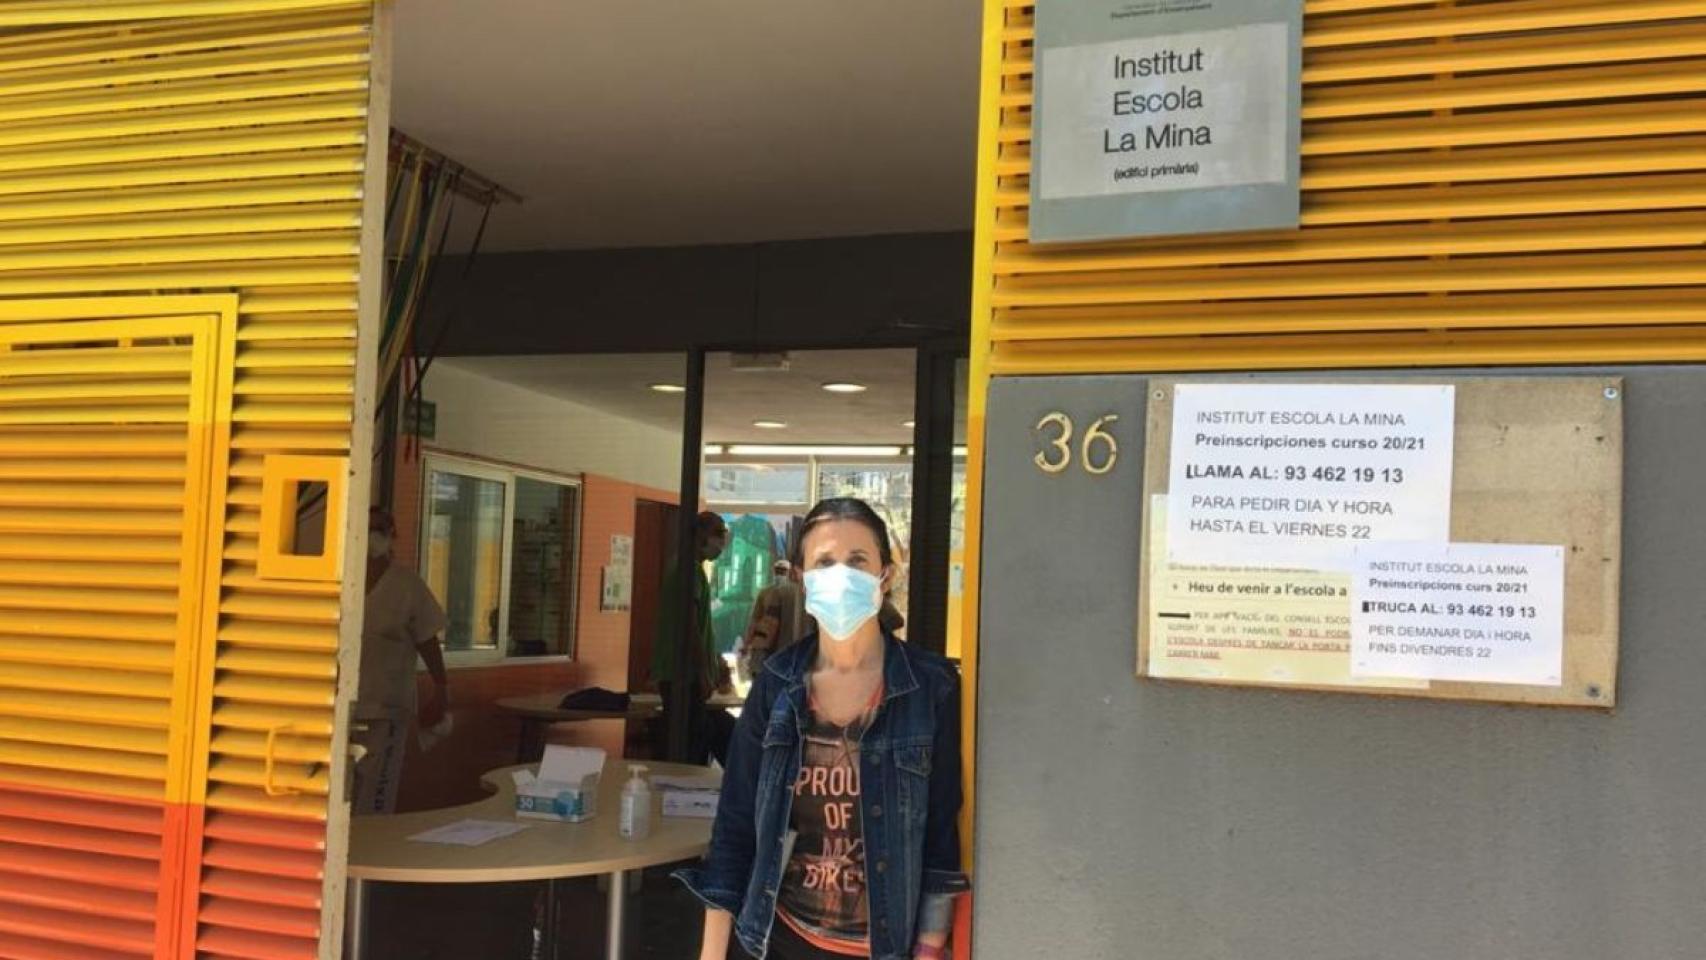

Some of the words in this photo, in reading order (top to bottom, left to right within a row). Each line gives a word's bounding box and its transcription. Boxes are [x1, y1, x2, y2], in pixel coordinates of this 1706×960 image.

[1114, 47, 1204, 79] Institut
[1114, 85, 1203, 116] Escola
[1104, 129, 1136, 153] La
[1145, 123, 1211, 150] Mina
[1197, 411, 1265, 425] INSTITUT
[1270, 411, 1335, 425] ESCOLA
[1339, 412, 1360, 425] LA
[1364, 412, 1406, 426] MINA
[1034, 411, 1118, 474] 36
[1195, 433, 1326, 449] Preinscripciones
[1331, 437, 1378, 449] curso
[1382, 436, 1425, 450] 20/21
[1186, 464, 1244, 479] LLAMA
[1249, 466, 1279, 480] AL:
[1284, 465, 1306, 480] 93
[1312, 466, 1346, 482] 462
[1353, 467, 1375, 482] 19
[1381, 468, 1404, 483] 13
[1191, 495, 1235, 509] PARA
[1240, 496, 1290, 511] PEDIR
[1295, 498, 1323, 512] DIA
[1327, 500, 1338, 513] Y
[1343, 500, 1393, 515] HORA
[1190, 519, 1244, 533] HASTA
[1248, 521, 1269, 534] EL
[1274, 522, 1347, 538] VIERNES
[1351, 526, 1371, 539] 22
[1369, 562, 1422, 572] INSTITUT
[1426, 562, 1475, 574] ESCOLA
[1478, 564, 1493, 574] LA
[1497, 565, 1528, 575] MINA
[1189, 580, 1214, 593] Heu
[1217, 581, 1234, 594] de
[1237, 583, 1270, 595] venir
[1274, 587, 1282, 595] a
[1285, 583, 1335, 597] l'escola
[1338, 588, 1347, 597] a
[1369, 578, 1462, 591] Preinscripcions
[1466, 582, 1492, 592] curs
[1496, 582, 1528, 593] 20/21
[1370, 602, 1417, 613] TRUCA
[1420, 604, 1443, 614] AL:
[1448, 604, 1464, 615] 93
[1468, 605, 1494, 617] 462
[1498, 606, 1515, 617] 19
[1520, 607, 1536, 618] 13
[1369, 625, 1394, 635] PER
[1397, 626, 1461, 639] DEMANAR
[1464, 628, 1486, 639] DIA
[1494, 630, 1531, 641] HORA
[1369, 643, 1397, 653] FINS
[1401, 645, 1474, 656] DIVENDRES
[1476, 647, 1491, 658] 22
[824, 802, 853, 830] OF
